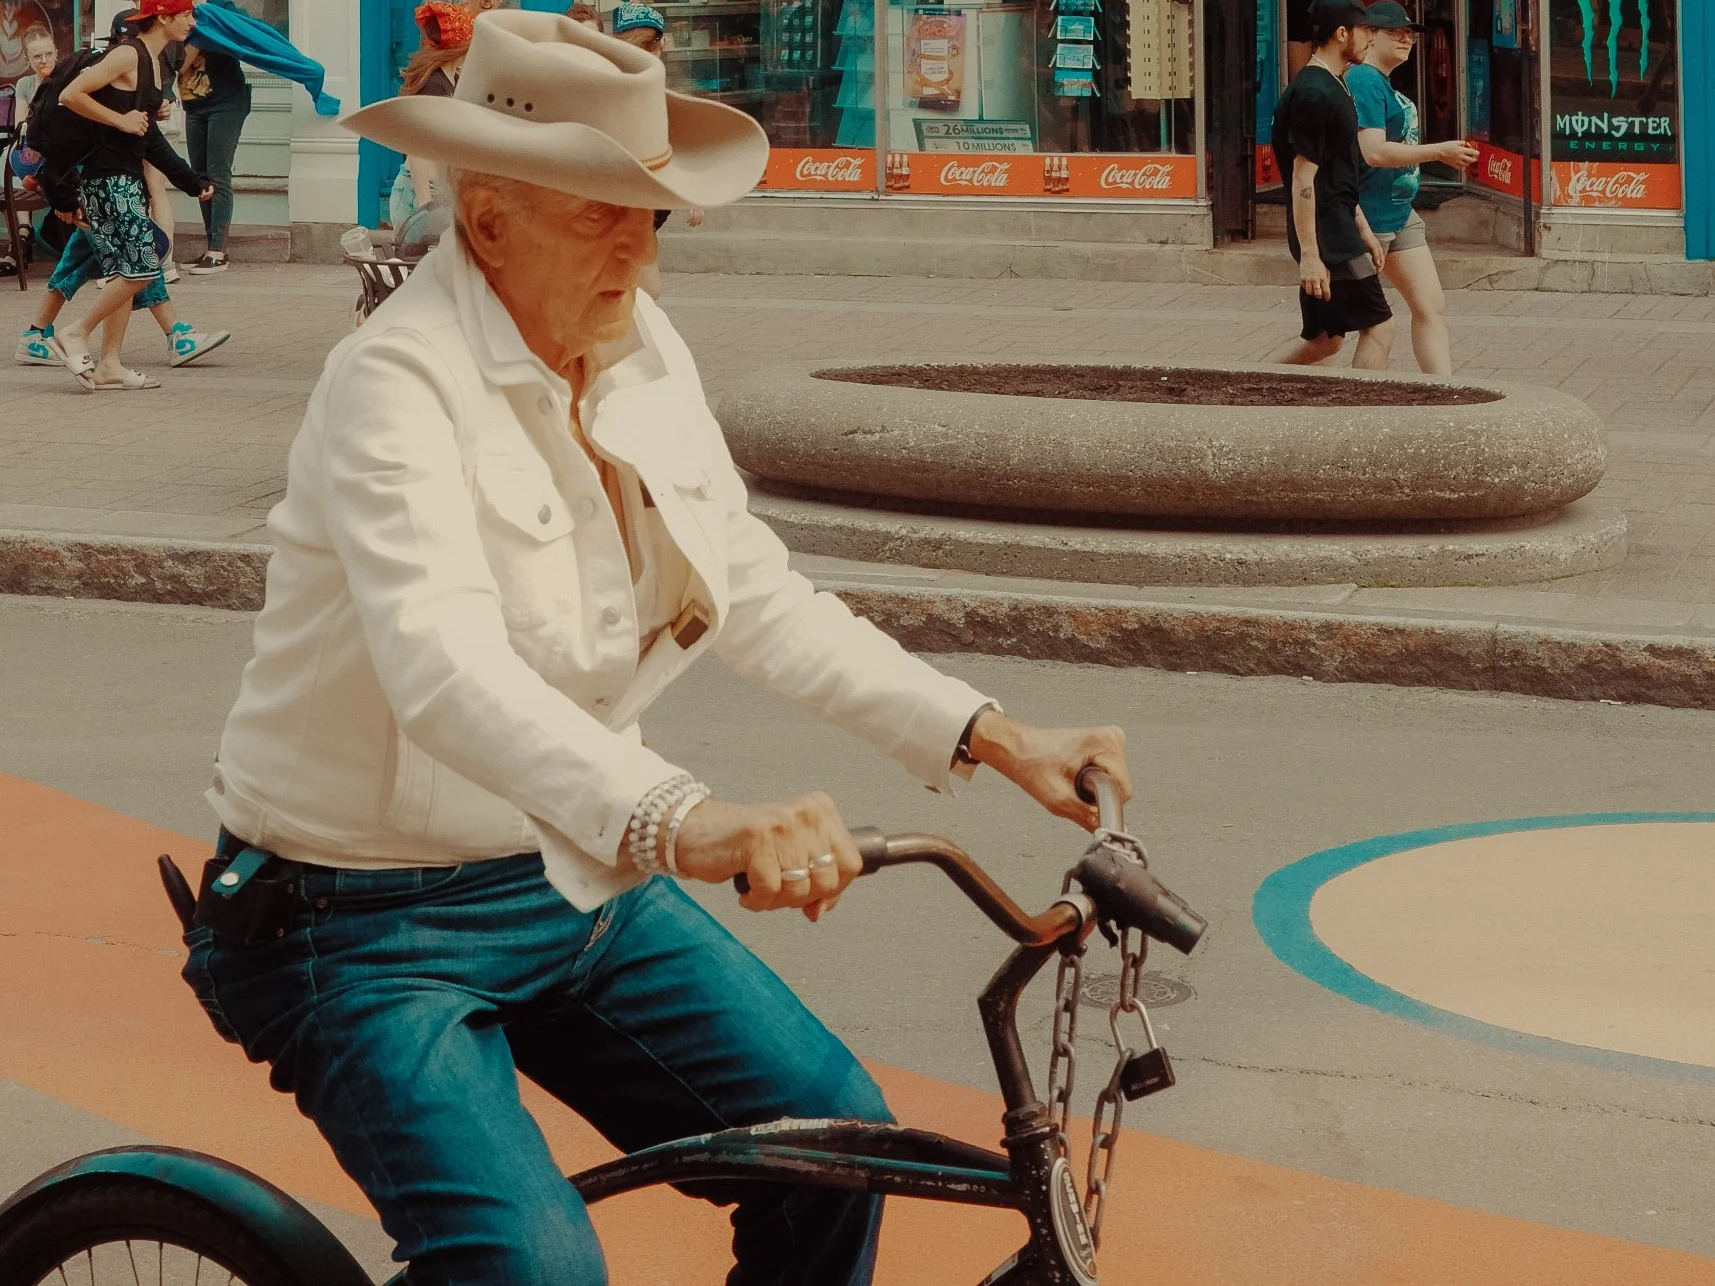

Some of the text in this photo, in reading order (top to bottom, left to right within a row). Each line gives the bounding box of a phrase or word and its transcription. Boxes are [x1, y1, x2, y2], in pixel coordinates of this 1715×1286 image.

[942, 123, 961, 136] 26
[956, 141, 970, 152] 10
[1569, 140, 1661, 151] ENERGY
